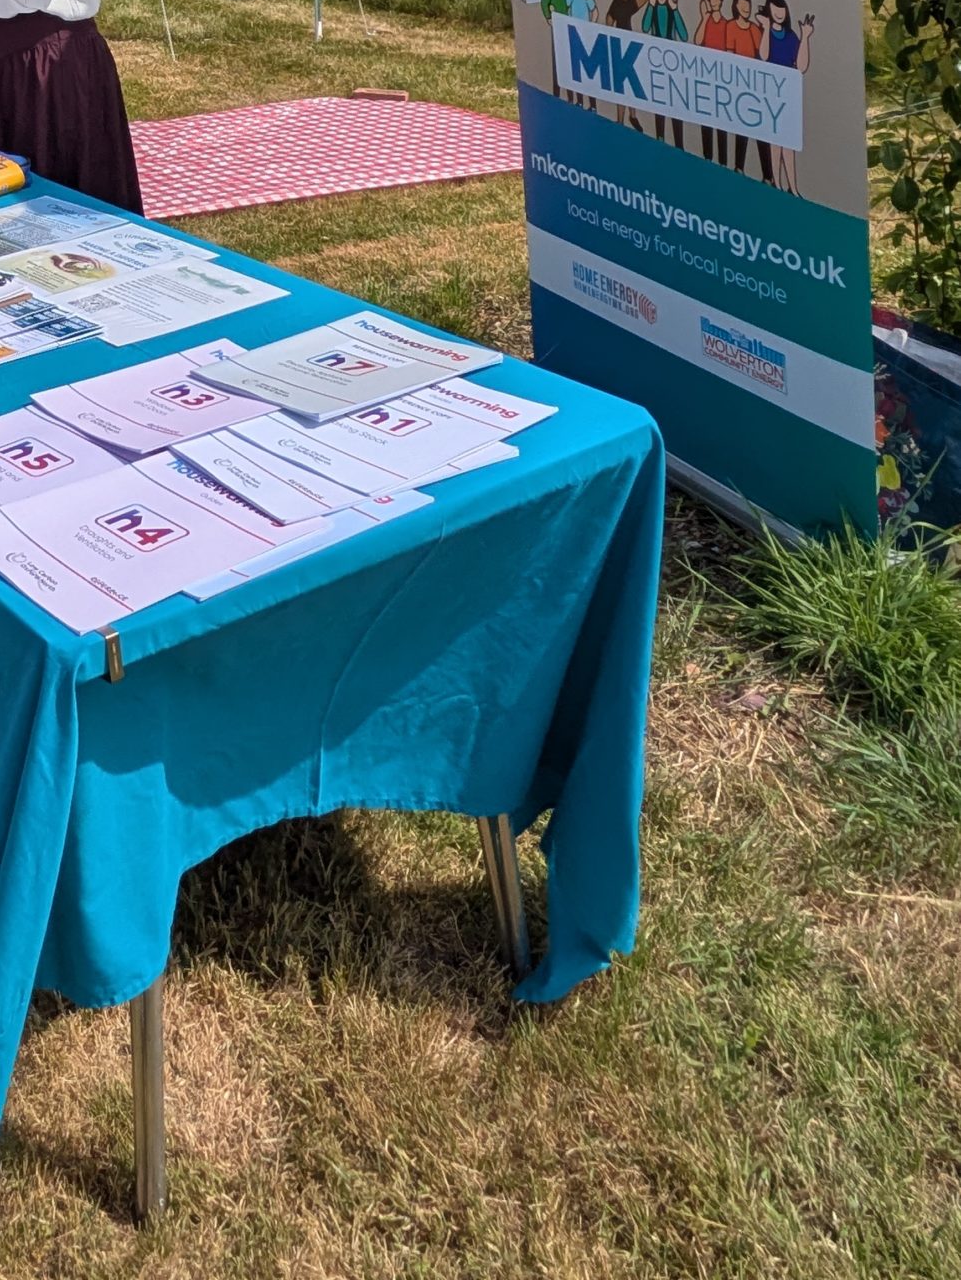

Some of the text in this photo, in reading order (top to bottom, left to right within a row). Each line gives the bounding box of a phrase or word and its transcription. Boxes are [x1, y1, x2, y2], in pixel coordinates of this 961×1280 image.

[567, 24, 787, 101] MK COMMUNITY
[649, 70, 787, 134] ENERGY
[531, 151, 847, 289] mkcommunityenergy.co.uk
[567, 199, 788, 305] local energy for local people
[572, 261, 639, 308] HOME ENERGY
[354, 319, 469, 362] housewarming
[703, 333, 784, 381] WOLVERTON
[315, 352, 377, 372] h7
[704, 347, 750, 373] COMMUNITY
[159, 384, 215, 406] h3
[429, 384, 521, 419] ewarming
[357, 406, 418, 433] h1
[359, 430, 389, 446] Stock
[0, 440, 62, 472] h5
[5, 471, 21, 481] and
[77, 525, 135, 559] Draughts and
[104, 509, 174, 546] h4
[72, 533, 115, 561] Ventilation
